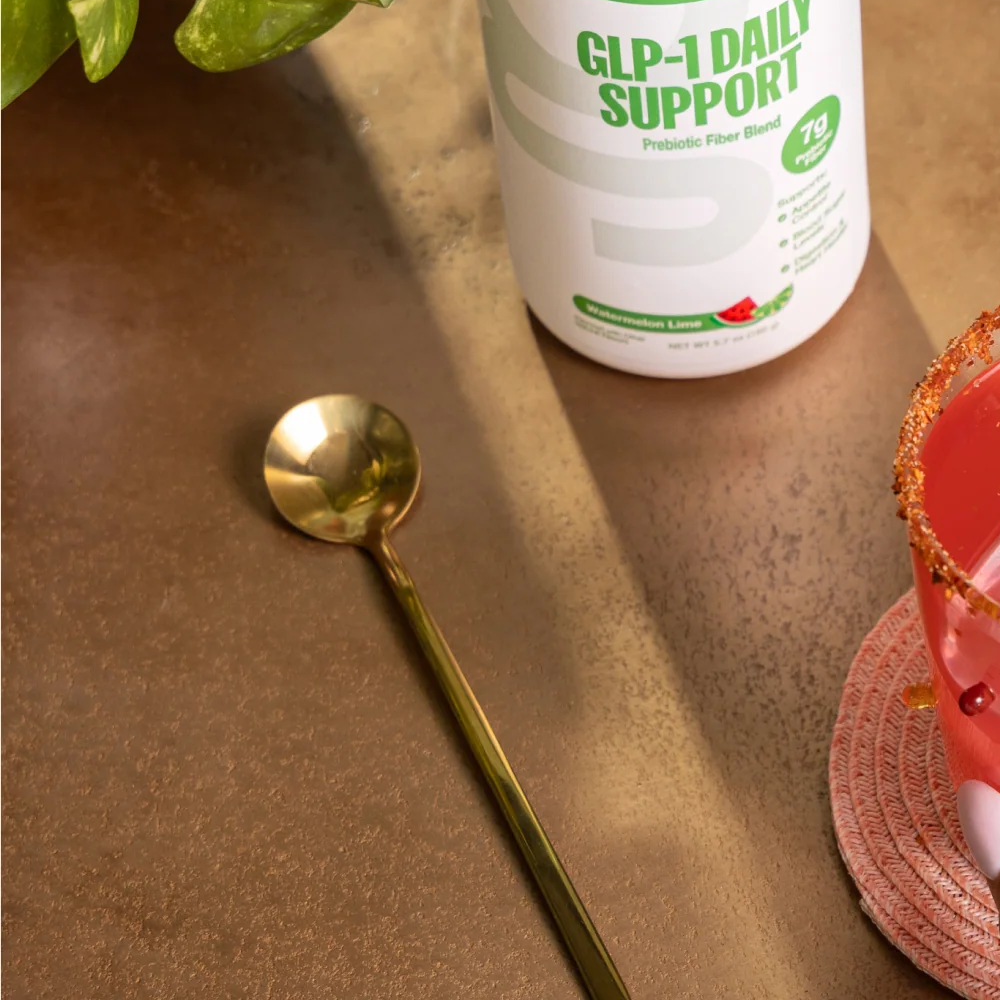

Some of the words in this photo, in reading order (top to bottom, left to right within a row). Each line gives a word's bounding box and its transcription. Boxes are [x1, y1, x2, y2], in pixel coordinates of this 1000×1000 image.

[577, 30, 700, 82] GLP-1
[598, 42, 802, 130] SUPPORT
[642, 135, 703, 151] Prebiotic
[706, 132, 740, 146] Fiber
[744, 114, 782, 139] Blend
[800, 111, 828, 146] 7g
[586, 303, 665, 330] Watermelon
[667, 320, 702, 330] Lime
